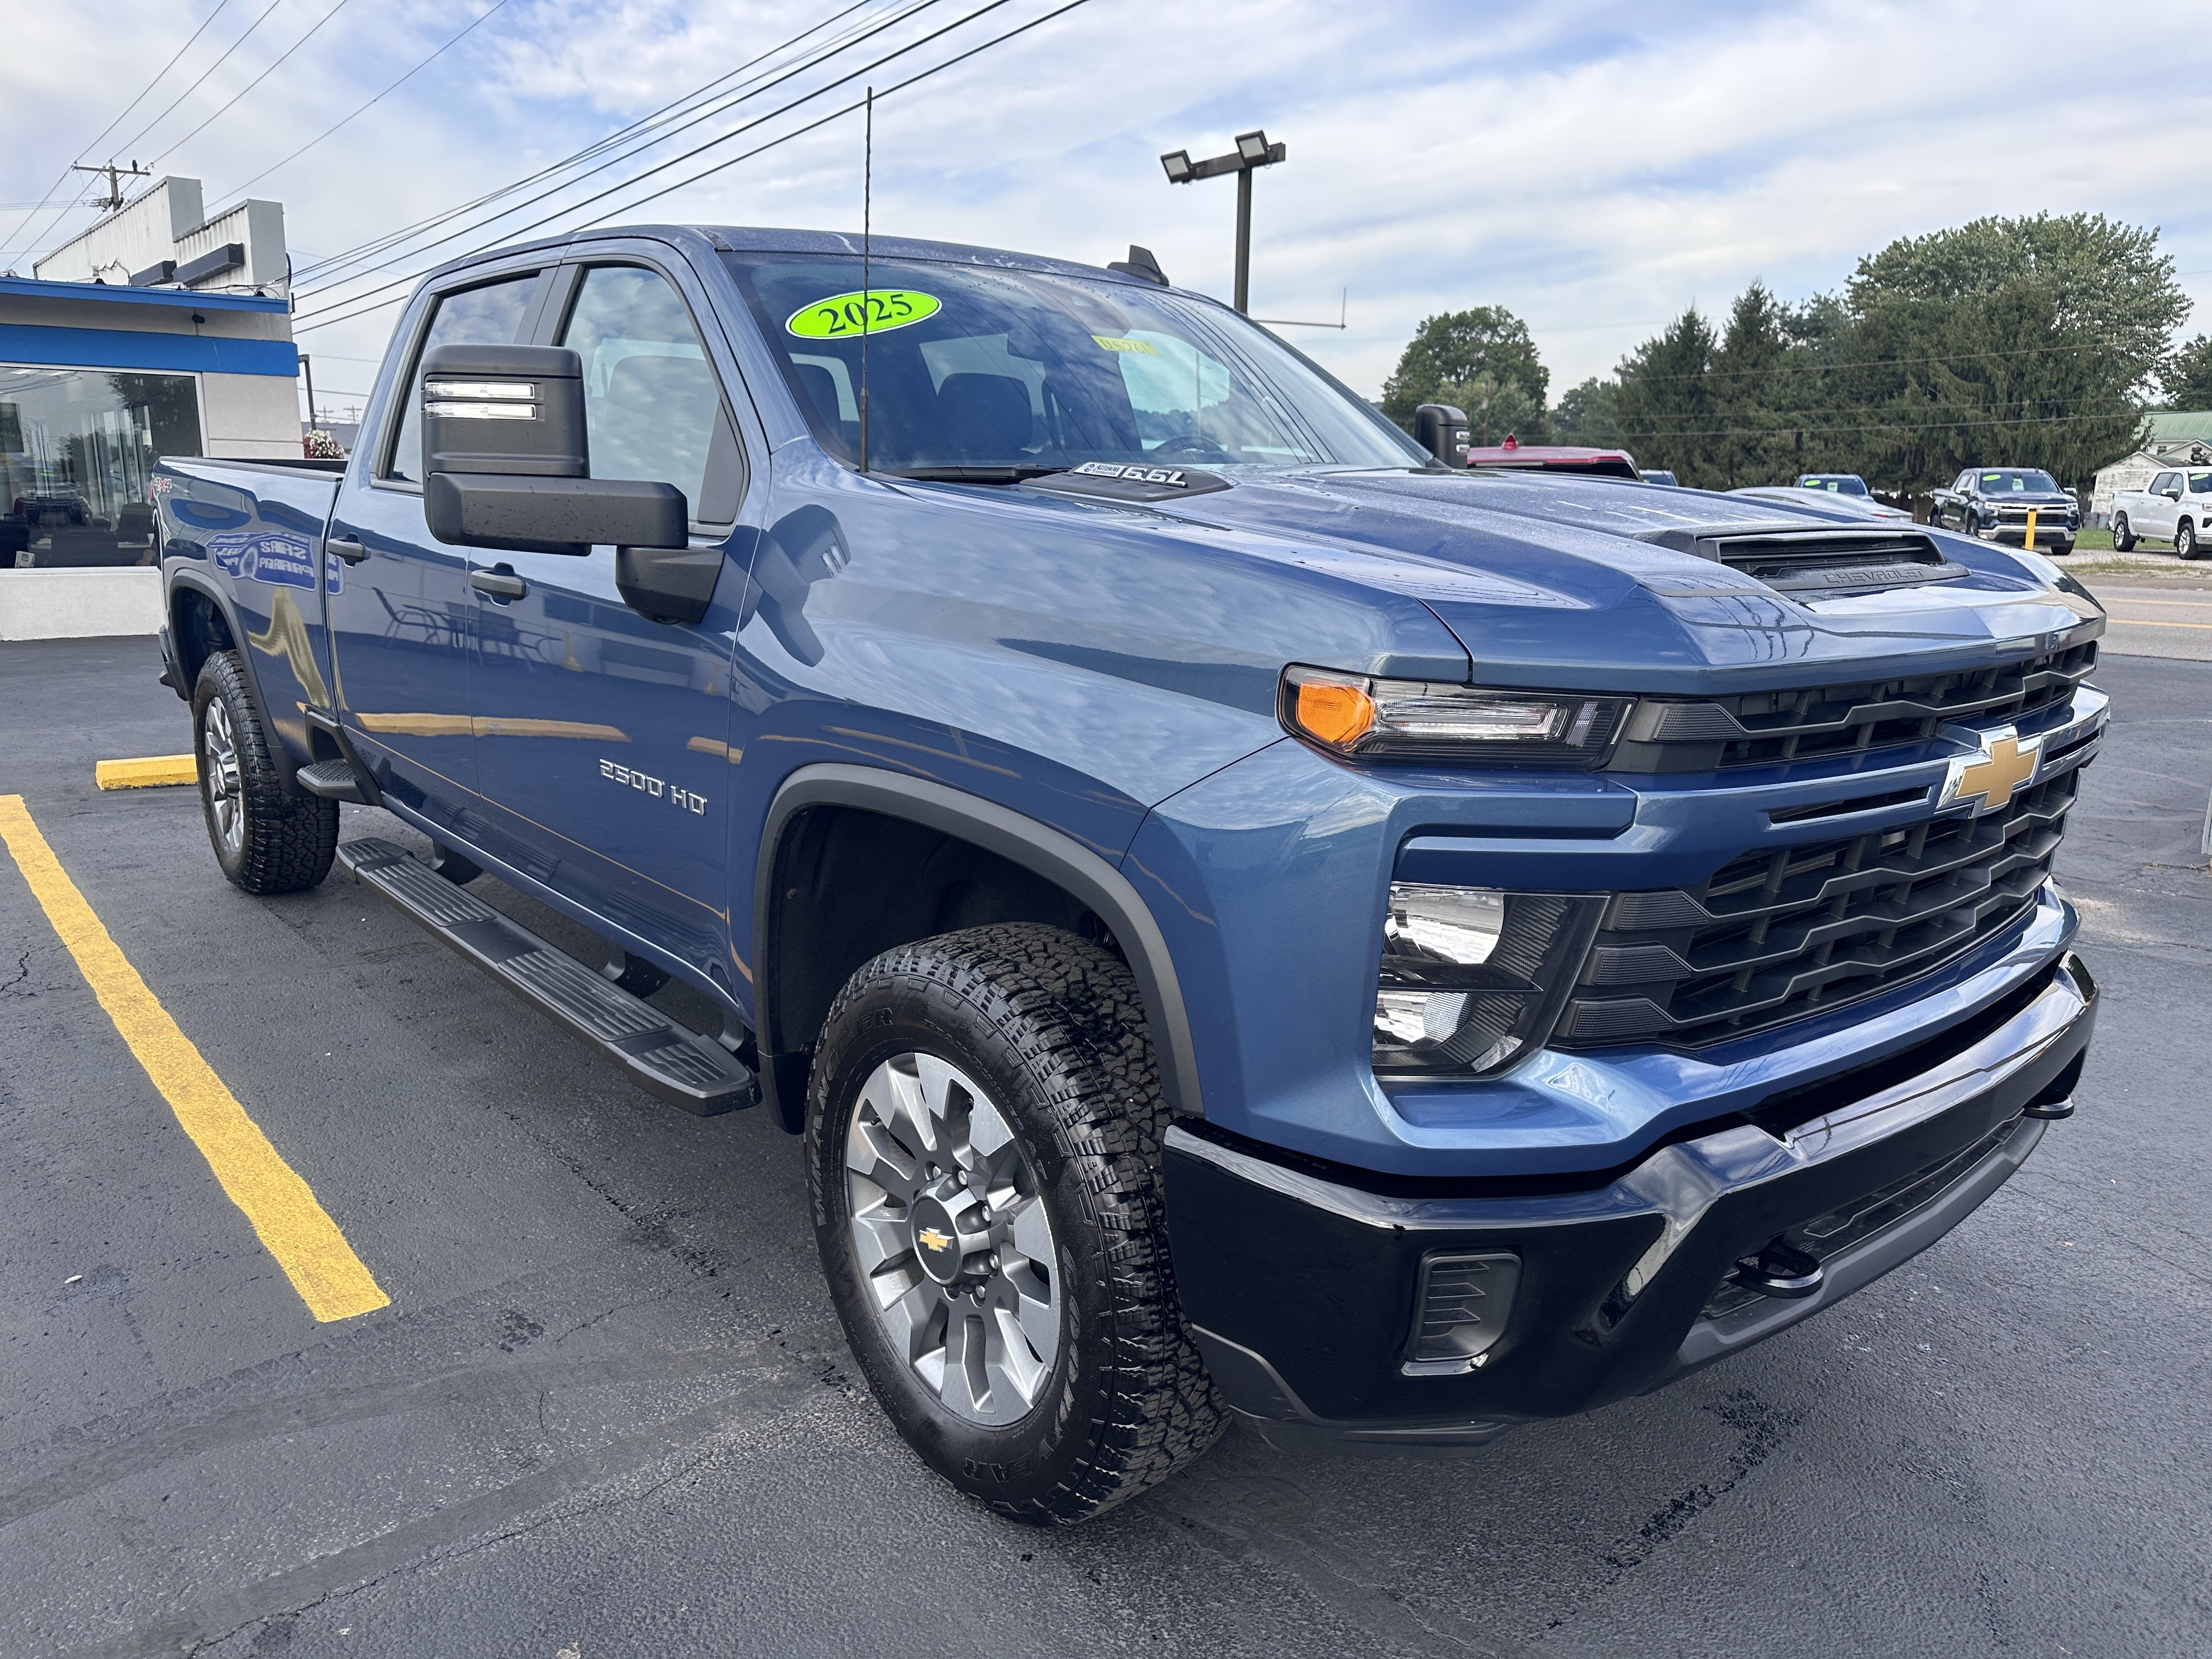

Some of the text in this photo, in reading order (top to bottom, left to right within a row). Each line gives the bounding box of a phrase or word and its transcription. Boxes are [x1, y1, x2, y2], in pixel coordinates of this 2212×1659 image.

[818, 293, 913, 334] 2025
[1823, 566, 1923, 584] CHEVROLET
[599, 758, 708, 816] 2500 HD
[811, 1007, 894, 1226] WRANGLER
[963, 1245, 1080, 1483] GOODYEAR
